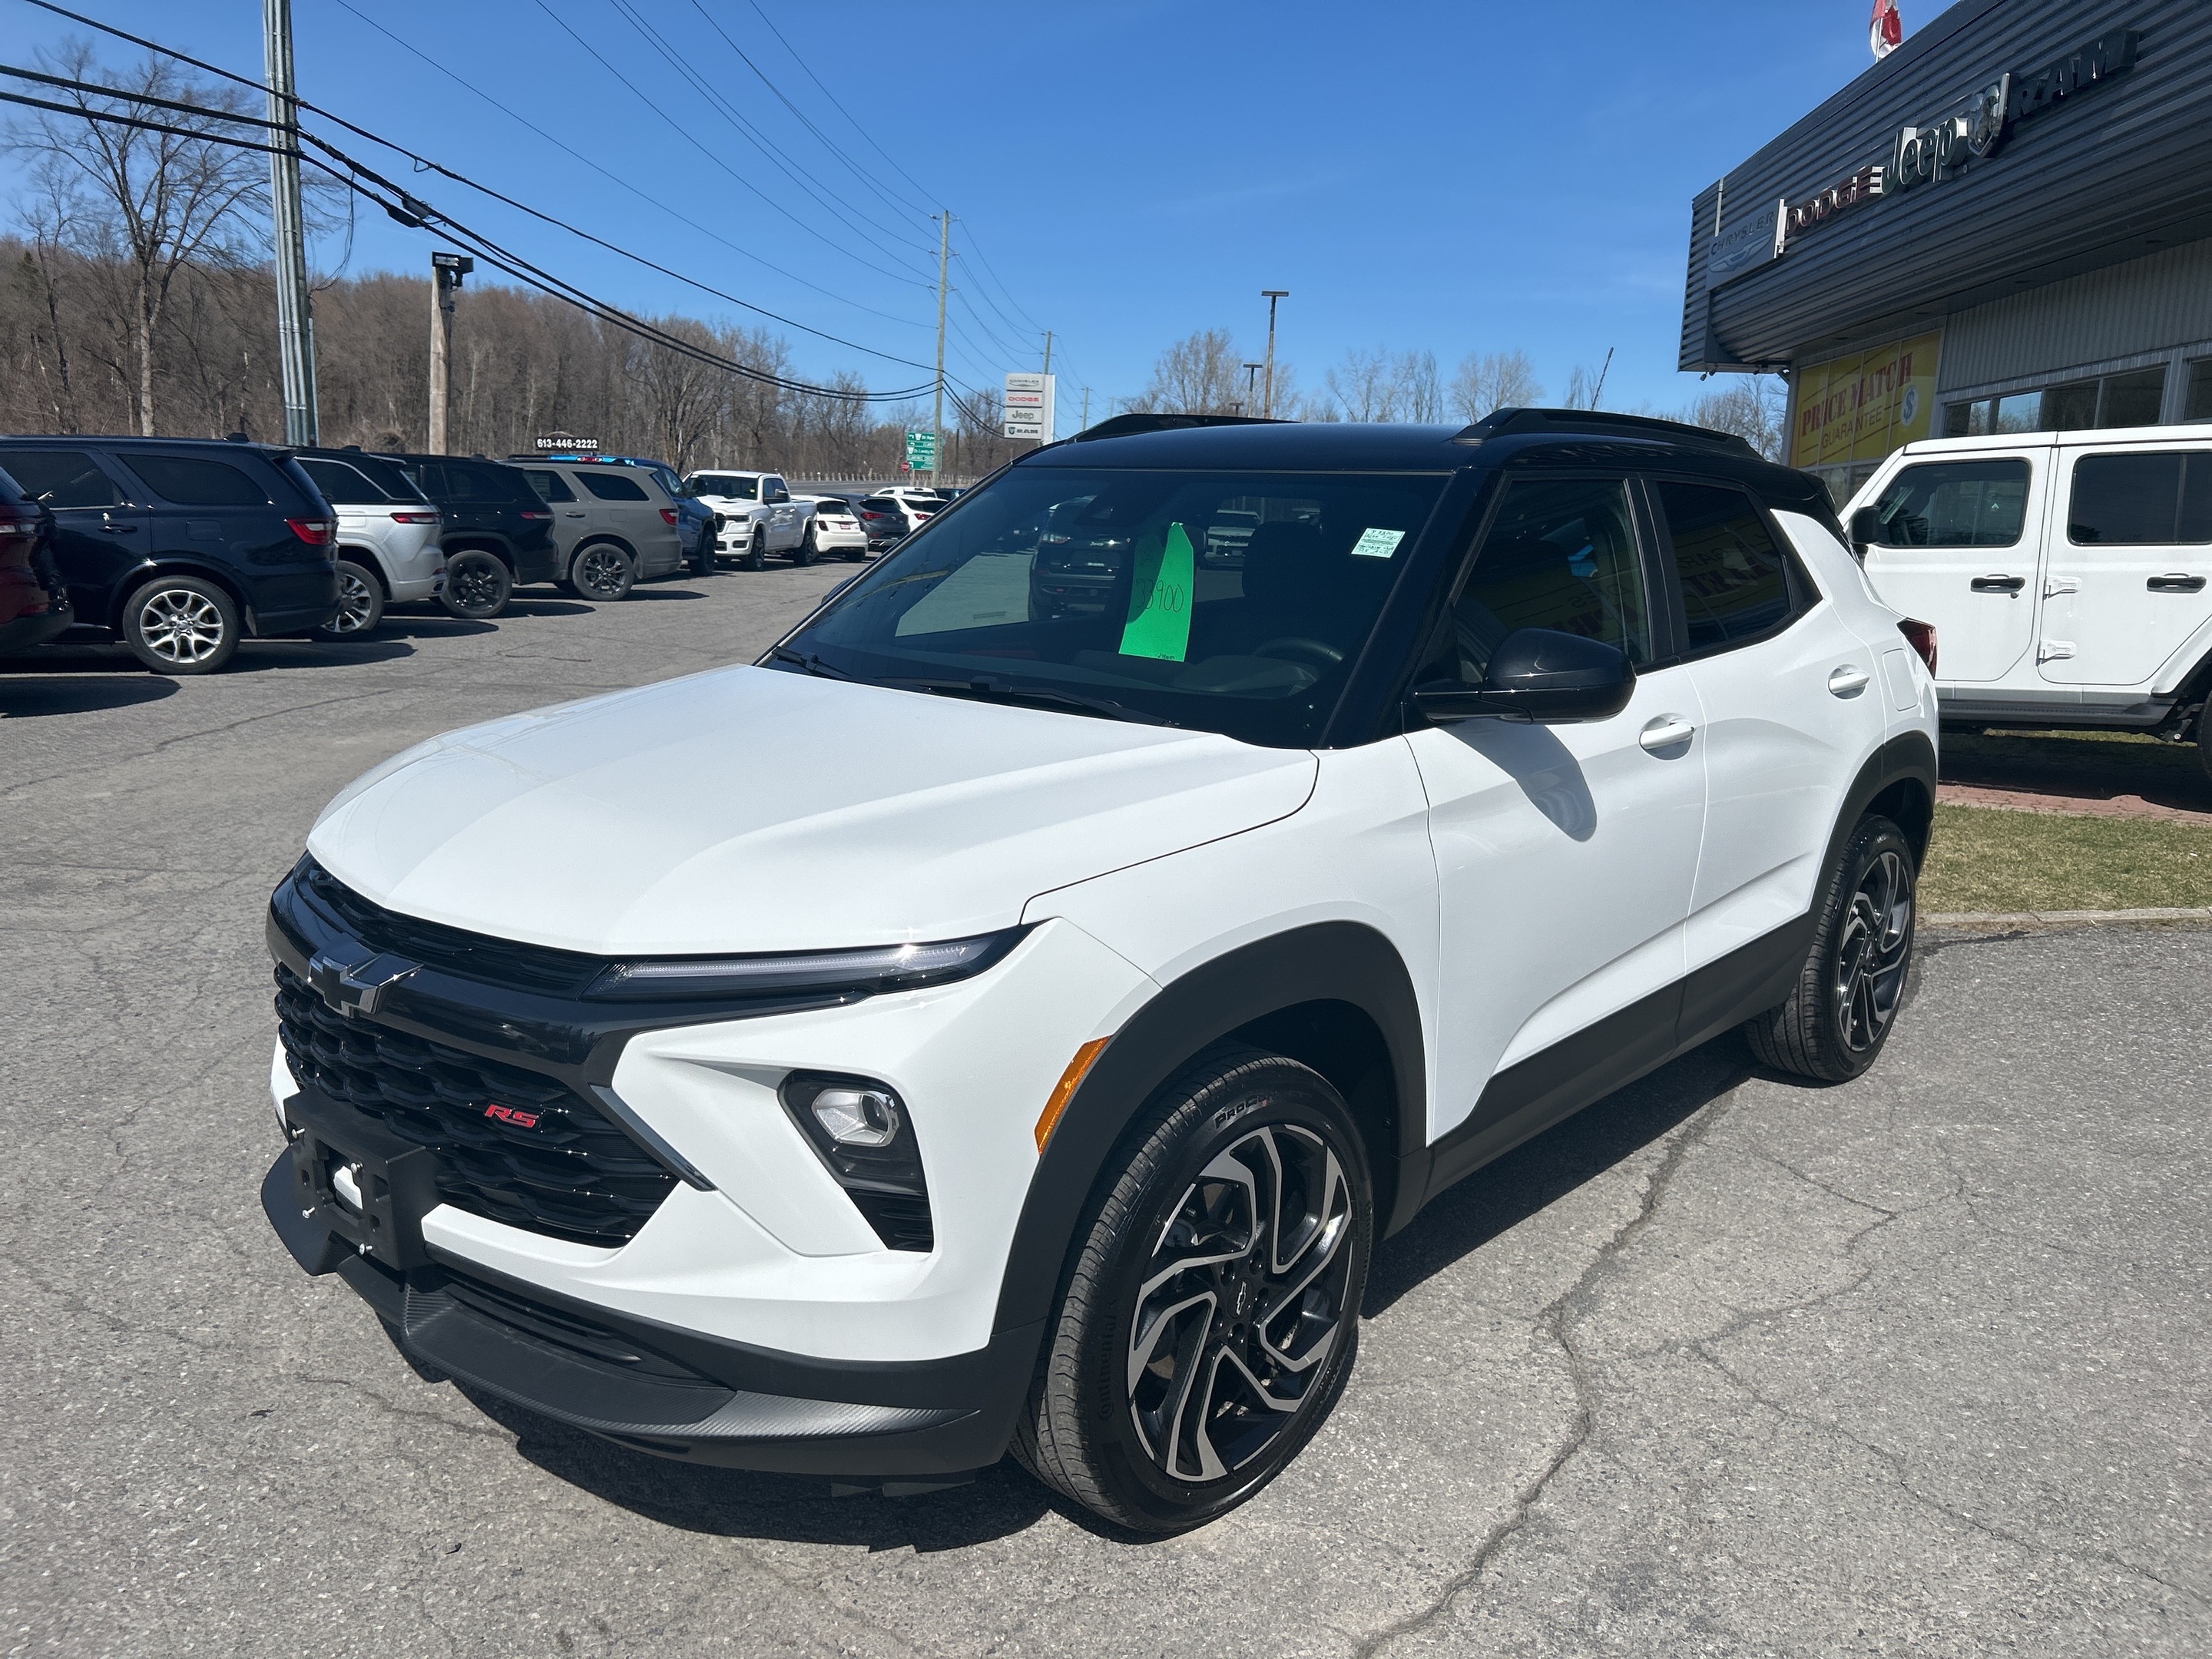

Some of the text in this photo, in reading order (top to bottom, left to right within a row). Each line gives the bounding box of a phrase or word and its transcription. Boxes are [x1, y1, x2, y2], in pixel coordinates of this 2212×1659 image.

[2008, 29, 2138, 123] RAM
[1881, 118, 1964, 194] Jeep
[1785, 166, 1880, 236] DODGE
[1710, 211, 1774, 257] CHRYSLER
[1012, 410, 1035, 421] Jeep
[1801, 351, 1913, 437] PRICE MATCH
[537, 439, 598, 449] 613-446-2222
[1822, 405, 1883, 449] GUARANTEE
[485, 1104, 539, 1128] RS
